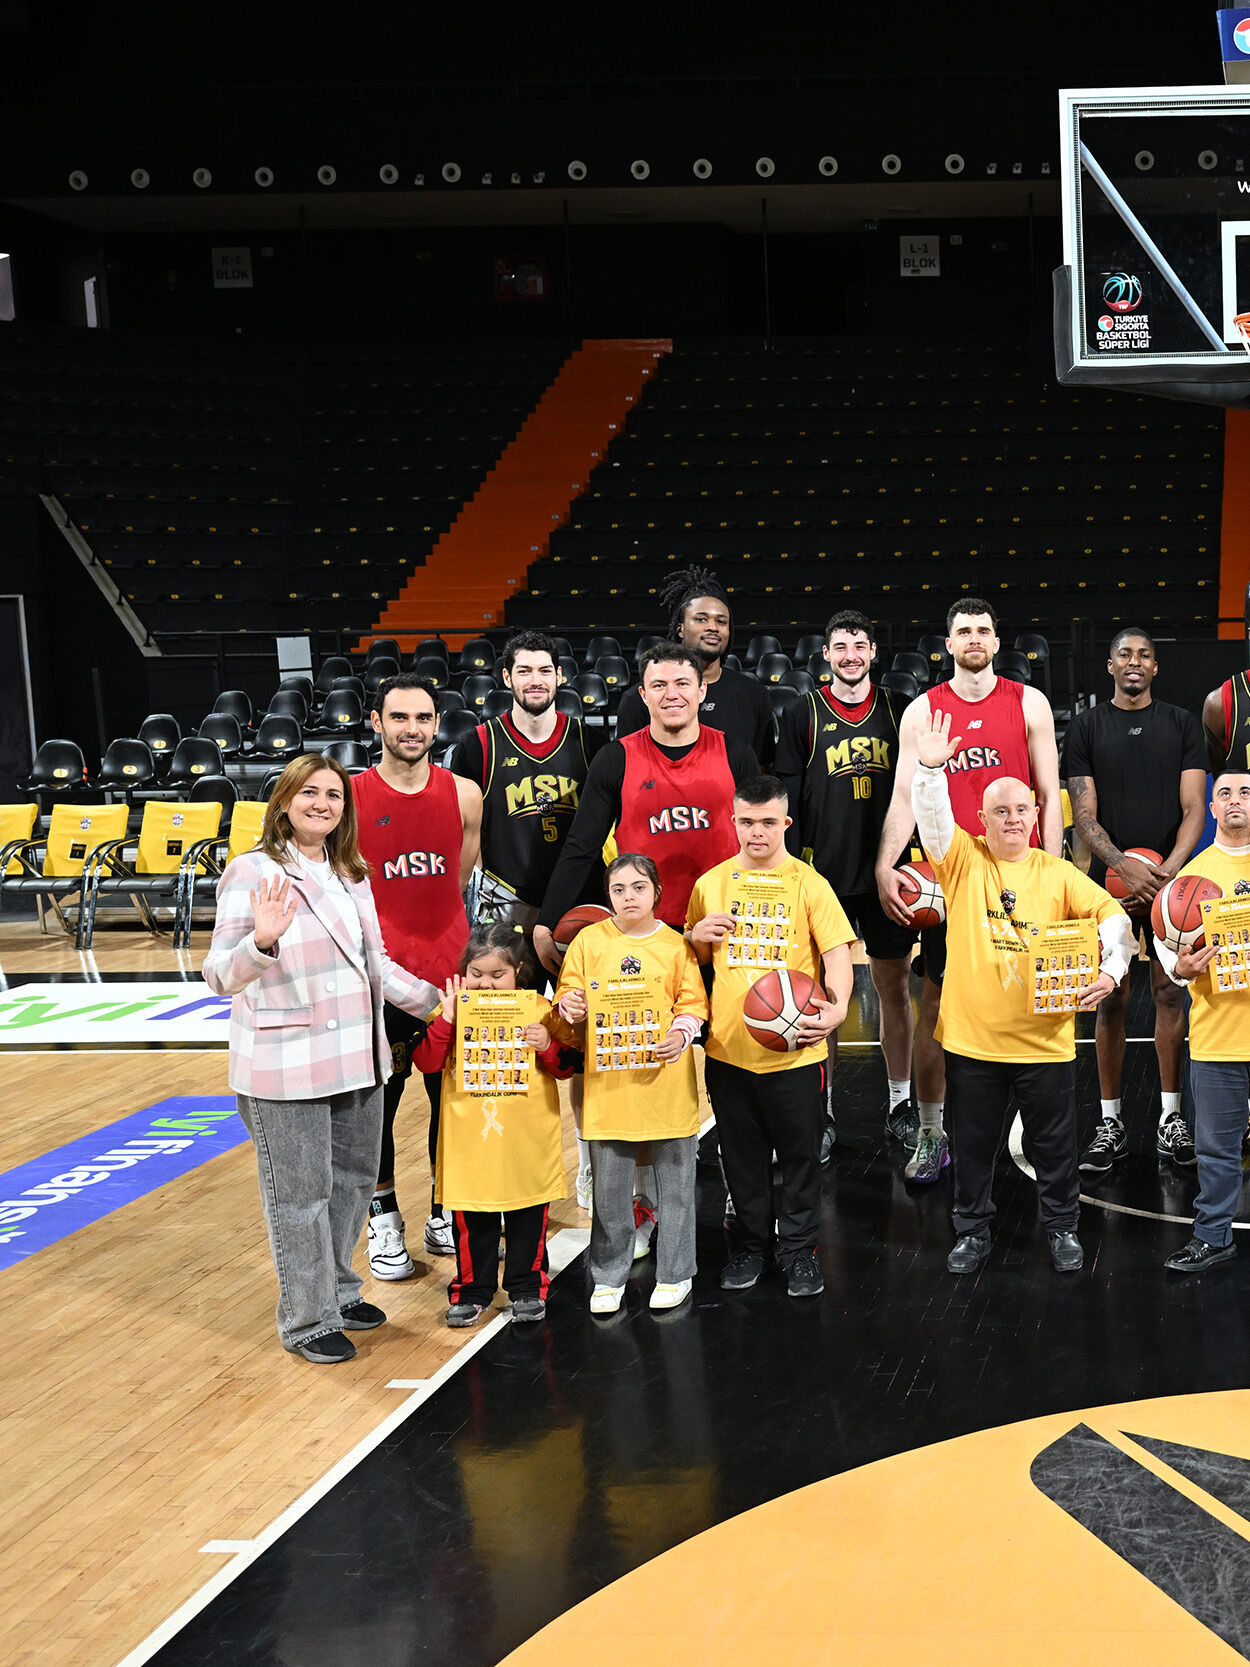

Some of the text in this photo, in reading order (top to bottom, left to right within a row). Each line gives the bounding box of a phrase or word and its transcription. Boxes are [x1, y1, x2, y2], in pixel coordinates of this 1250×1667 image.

[910, 243, 929, 253] L-1
[903, 258, 937, 268] BLOK
[1096, 331, 1152, 340] BASKETBOL
[1098, 340, 1130, 350] SÜPER
[825, 736, 890, 775] MSK
[946, 746, 1002, 774] MSK
[504, 774, 580, 812] MSK
[851, 776, 872, 800] 10
[541, 816, 559, 842] 5
[649, 806, 711, 834] MSK
[383, 851, 448, 880] MSK
